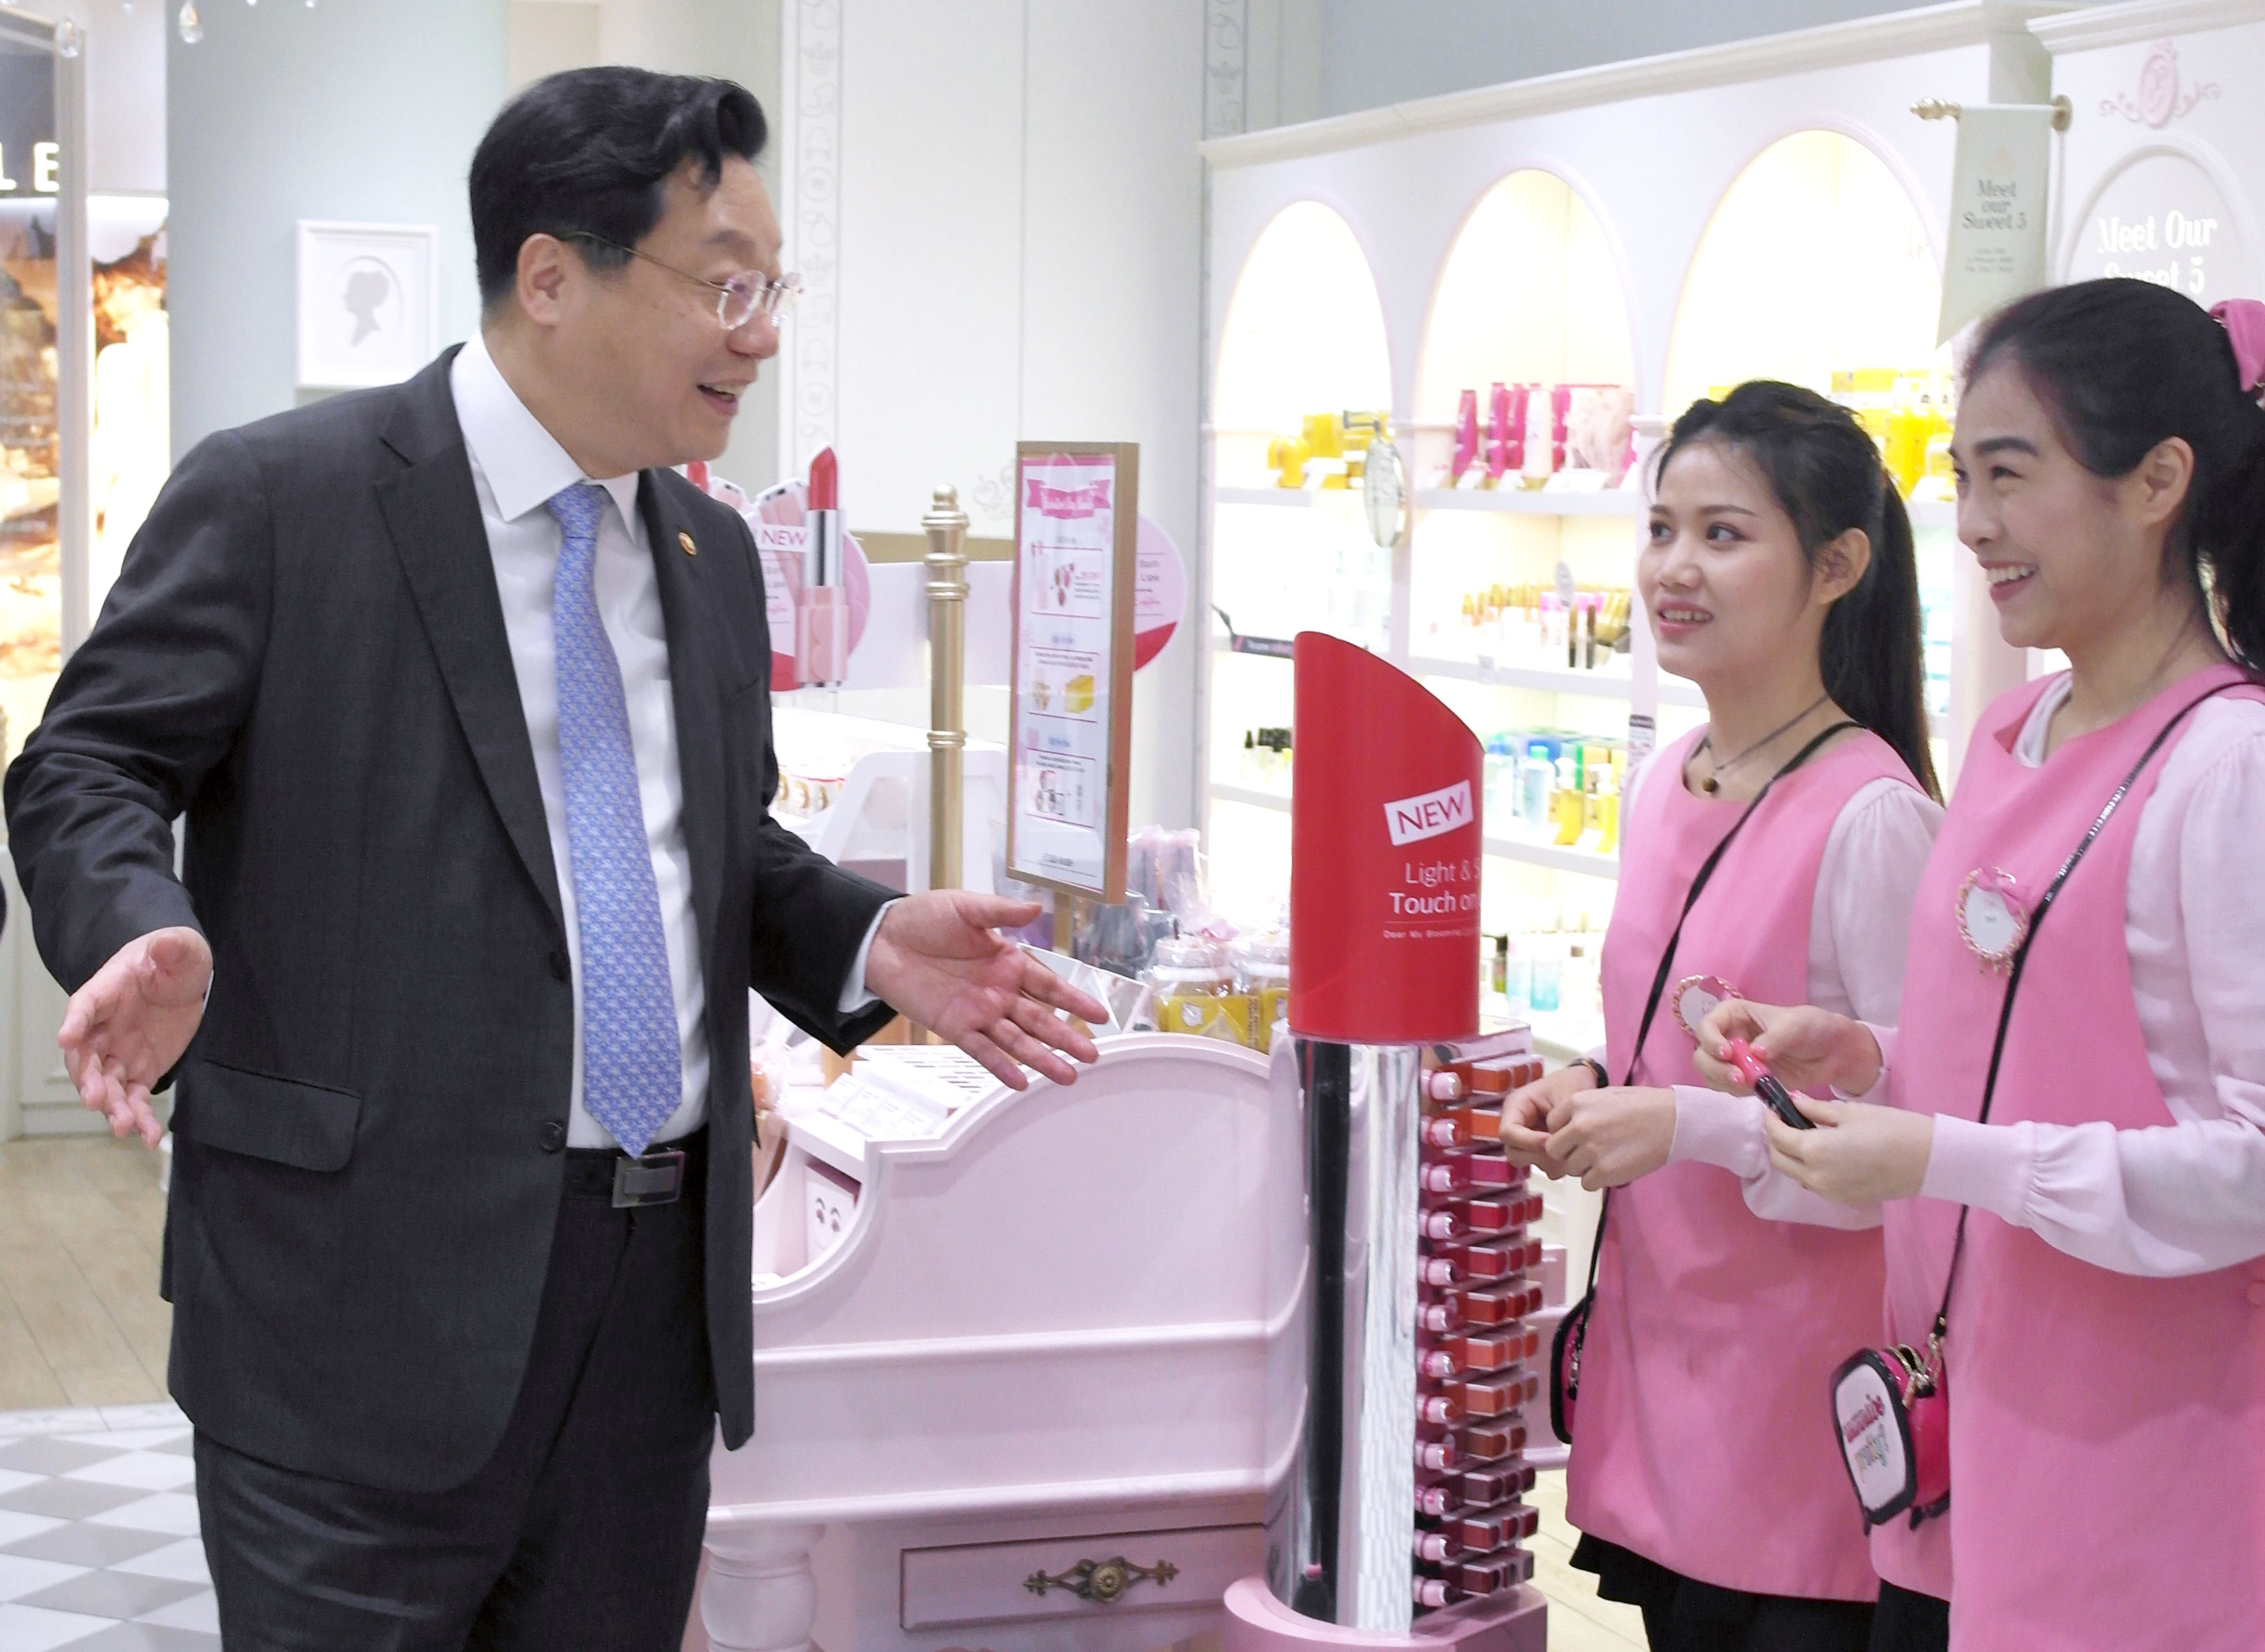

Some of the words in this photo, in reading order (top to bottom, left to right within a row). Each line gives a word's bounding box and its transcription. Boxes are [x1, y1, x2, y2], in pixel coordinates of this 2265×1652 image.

[1976, 179, 2017, 198] Meet
[1962, 211, 2012, 229] Sweet
[2096, 216, 2158, 253] Meet
[2165, 210, 2218, 249] Our
[2105, 261, 2180, 290] Seet
[2188, 256, 2205, 295] 5
[761, 528, 808, 546] NEW
[1396, 791, 1465, 834] NEW
[1405, 860, 1456, 887] Light
[1460, 859, 1471, 881] &
[1389, 890, 1456, 915] Touch
